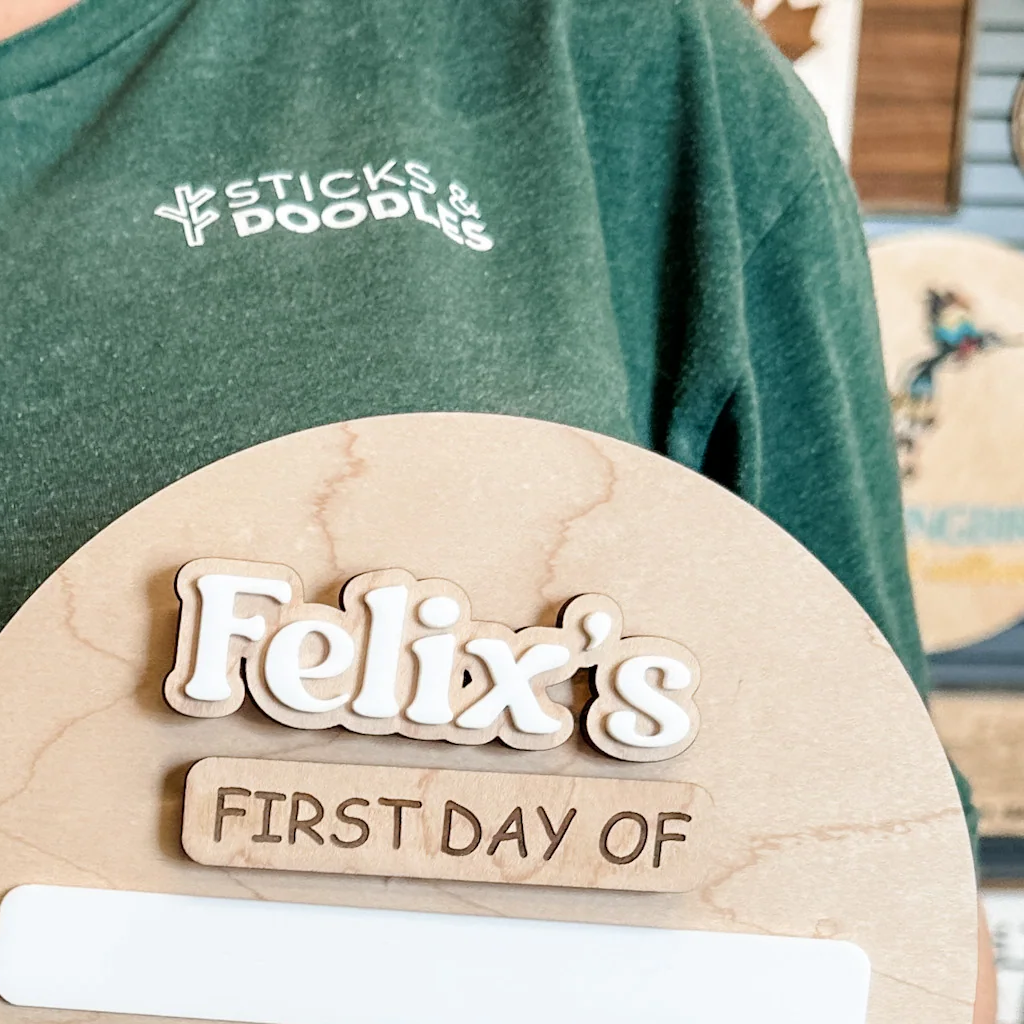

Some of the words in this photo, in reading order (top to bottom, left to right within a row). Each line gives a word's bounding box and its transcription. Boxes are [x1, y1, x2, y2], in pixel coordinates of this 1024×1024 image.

[225, 158, 437, 208] STICKS
[448, 180, 482, 218] &
[231, 190, 494, 252] DOODLES
[184, 573, 692, 748] Felix's
[212, 786, 422, 850] FIRST
[441, 799, 576, 861] DAY
[598, 810, 693, 869] OF
